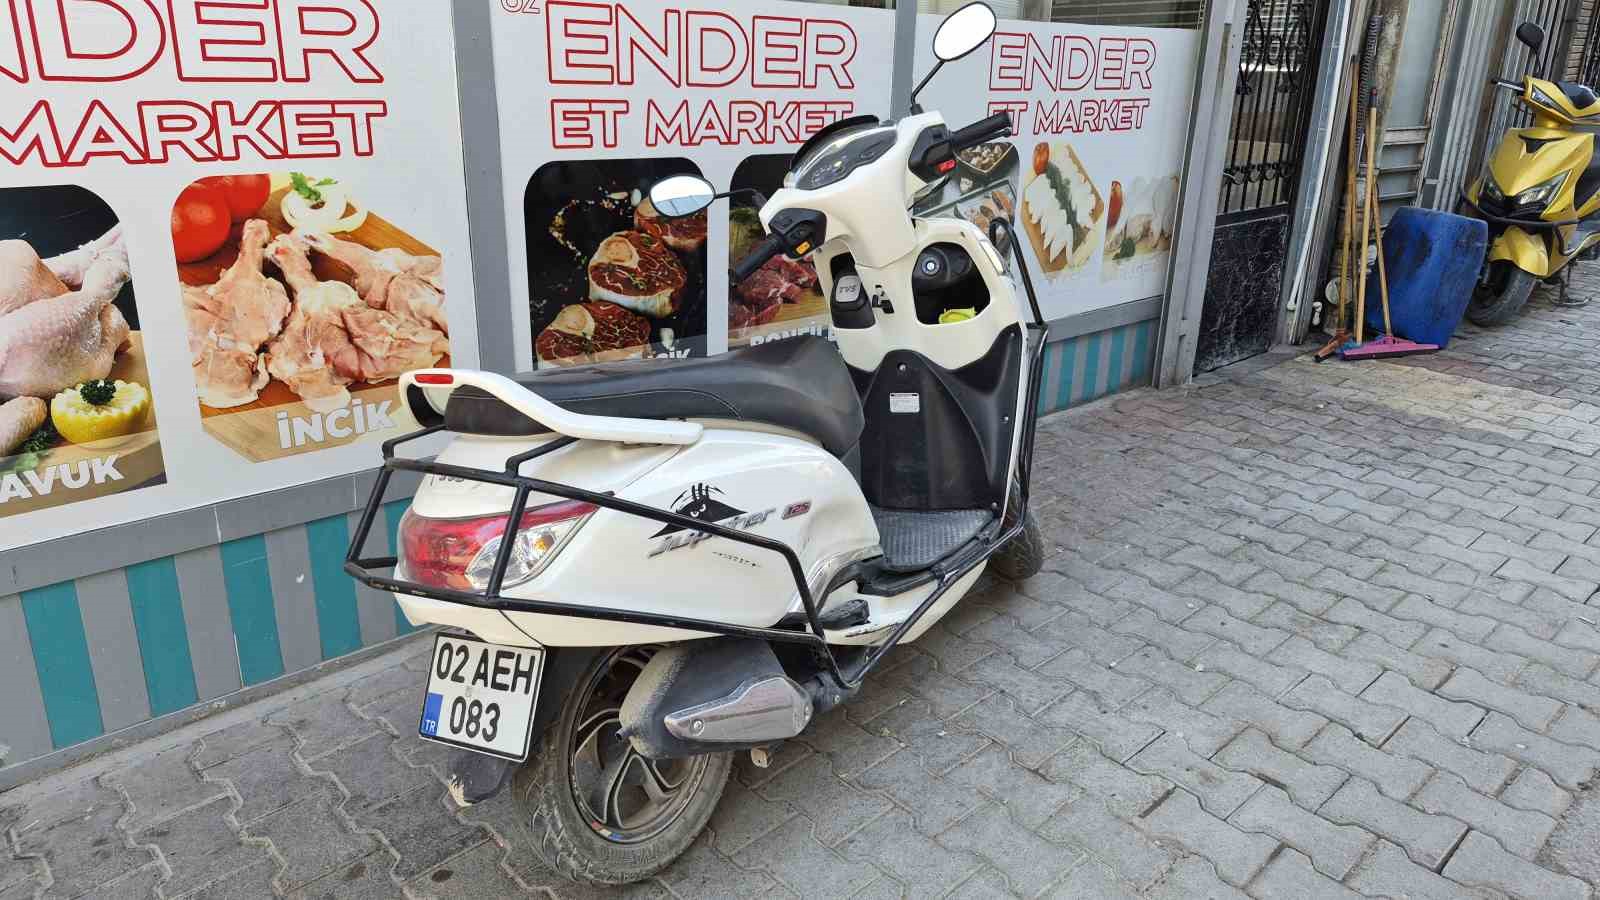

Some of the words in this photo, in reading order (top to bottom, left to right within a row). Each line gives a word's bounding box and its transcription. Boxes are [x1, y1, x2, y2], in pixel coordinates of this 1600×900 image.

[546, 0, 857, 89] ENDER
[989, 31, 1157, 92] ENDER
[551, 99, 630, 149] ET
[1033, 98, 1151, 136] MARKET
[277, 399, 398, 450] İNCİK
[436, 642, 470, 684] 02
[471, 648, 536, 695] AEH
[424, 718, 436, 732] TR
[450, 695, 500, 743] 083
